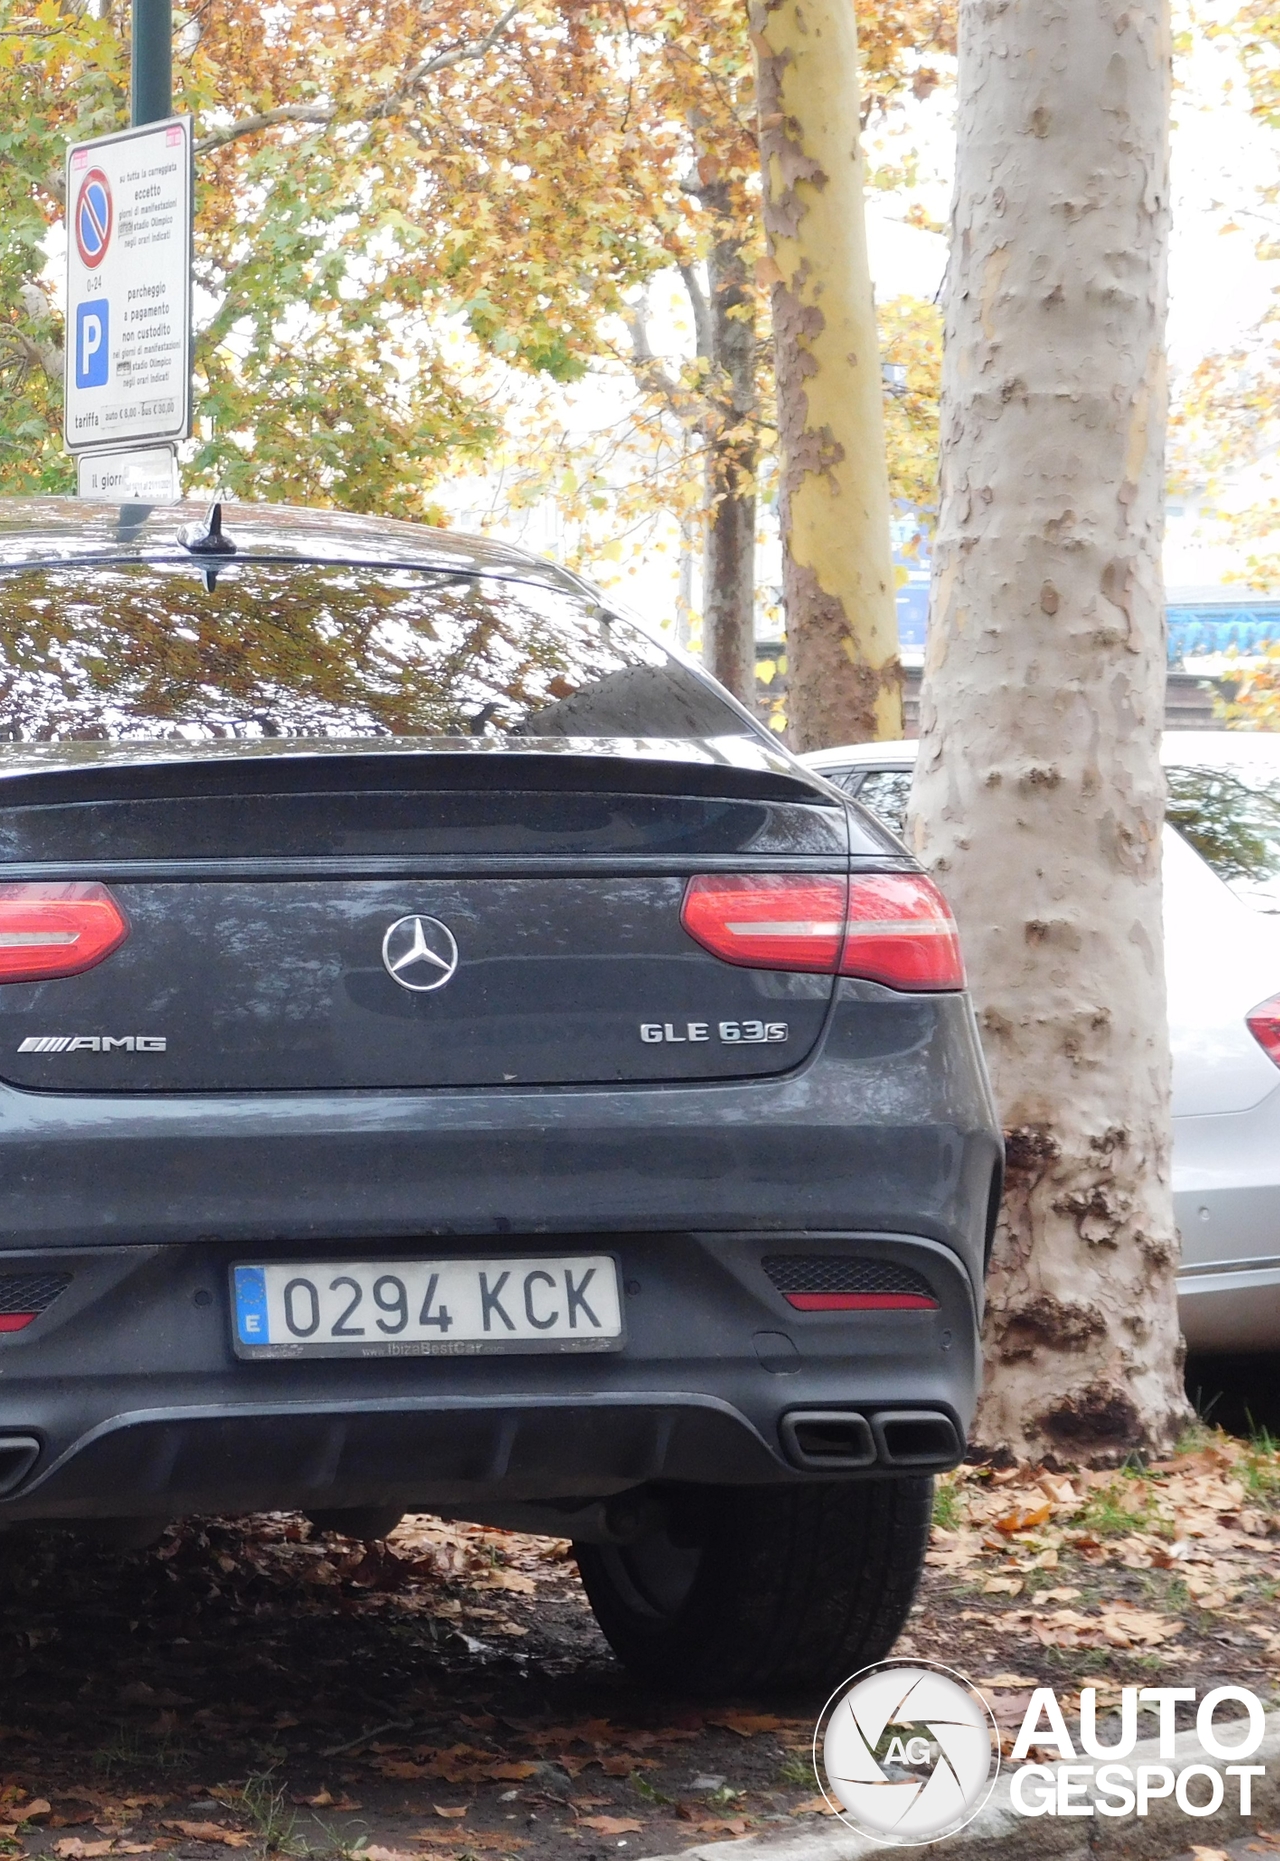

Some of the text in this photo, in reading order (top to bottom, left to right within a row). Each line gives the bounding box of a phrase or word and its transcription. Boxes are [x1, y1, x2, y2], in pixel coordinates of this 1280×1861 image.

[127, 171, 140, 182] tutta
[141, 168, 147, 179] la
[148, 163, 177, 177] carreggiata
[134, 183, 162, 200] eccetto
[118, 198, 178, 221] giorni di manifestazioni
[133, 220, 149, 231] stadio
[150, 215, 174, 228] Olimpico
[123, 229, 171, 249] negli orari indicati
[86, 275, 103, 293] 0-24
[127, 281, 166, 302] parcheggio
[123, 302, 170, 323] a pagamento
[122, 322, 171, 342] non custodito
[121, 346, 136, 360] giorni
[137, 344, 143, 355] di
[143, 339, 181, 354] manifestazioni
[132, 360, 148, 371] stadio
[149, 356, 172, 368] Olimpico
[122, 371, 170, 389] negli orari indicati
[75, 412, 99, 429] tariffa
[105, 411, 118, 421] auto
[119, 409, 123, 419] €
[124, 407, 137, 419] 8,00
[141, 406, 152, 417] bus
[153, 405, 157, 414] €
[158, 402, 175, 415] 30,00
[92, 473, 98, 488] il
[640, 1022, 710, 1043] GLE
[66, 1036, 167, 1052] AMG
[283, 1268, 602, 1339] 0294 KCK
[245, 1315, 261, 1332] E
